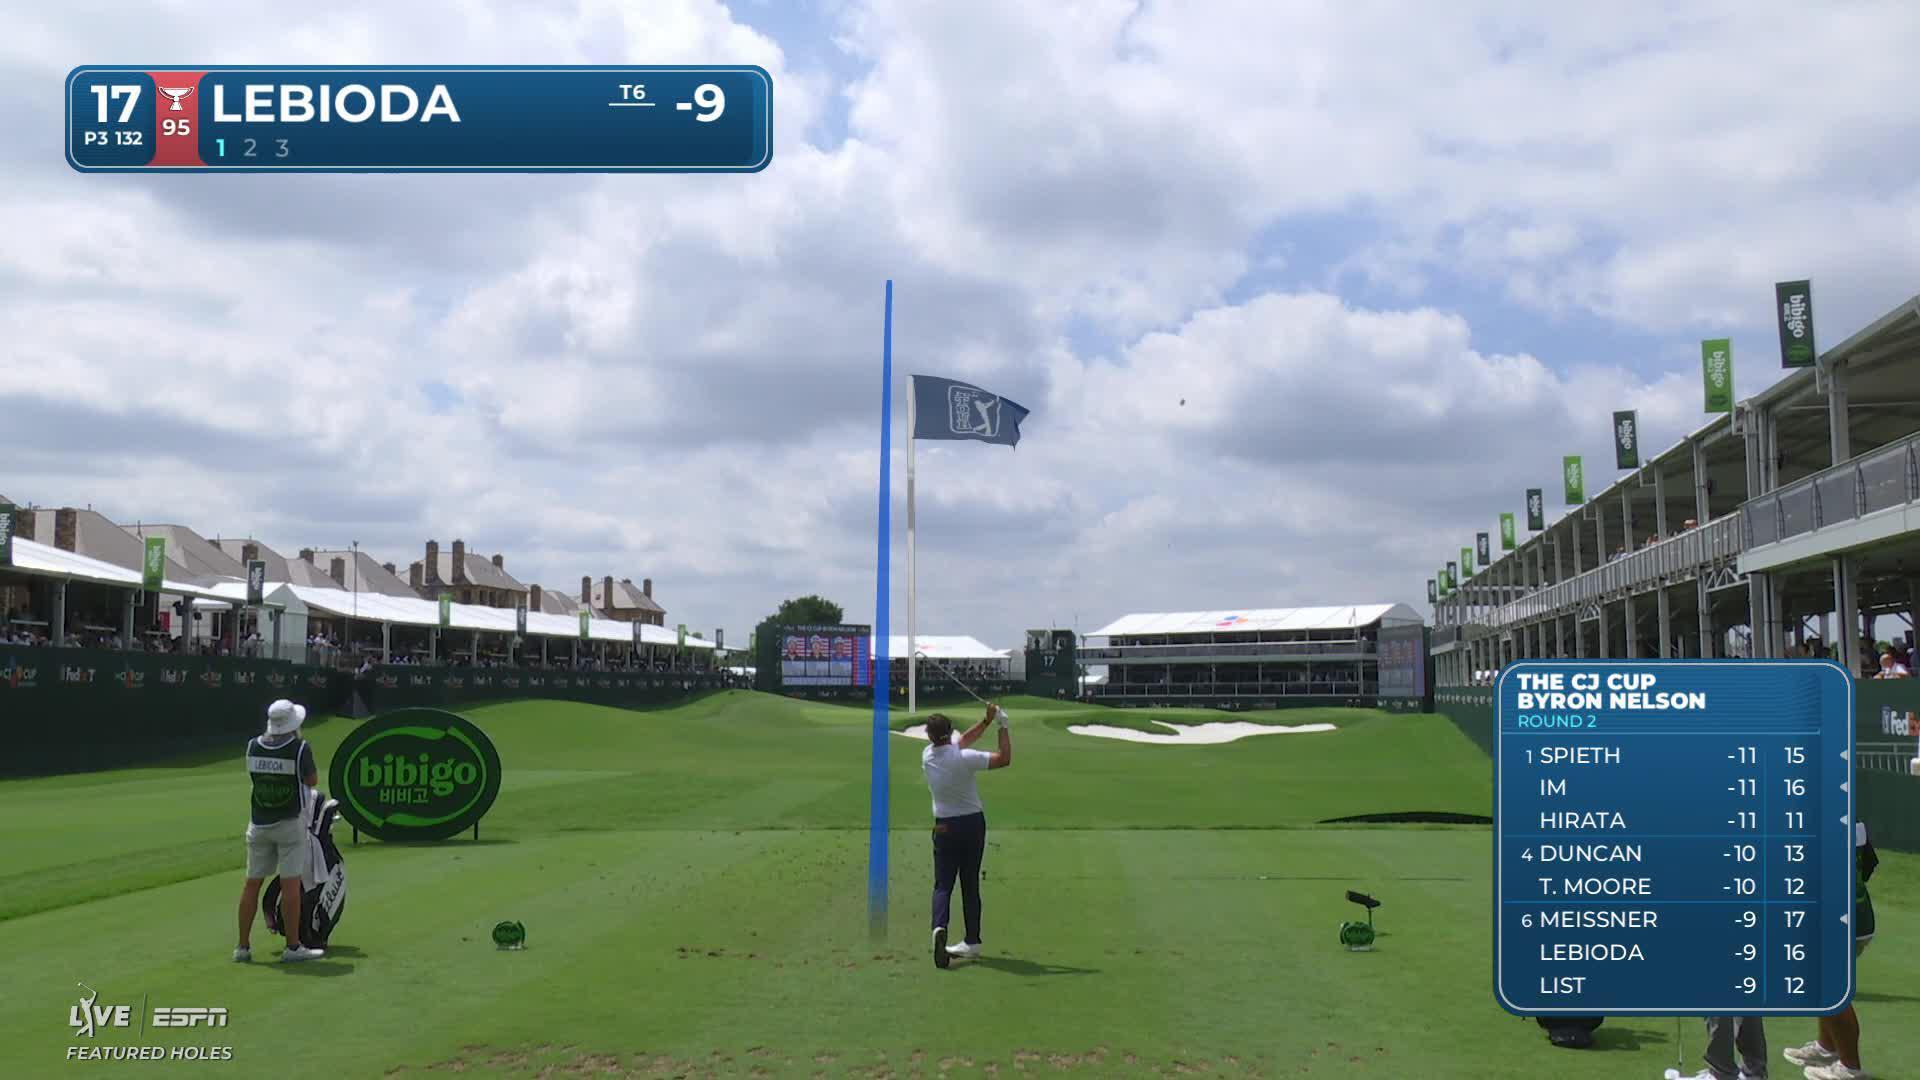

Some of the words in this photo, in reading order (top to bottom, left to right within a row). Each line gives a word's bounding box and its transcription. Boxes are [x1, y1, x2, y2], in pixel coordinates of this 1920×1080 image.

[1787, 294, 1807, 338] bibigo
[1711, 351, 1726, 388] bibigo
[1044, 655, 1055, 667] 17
[359, 752, 477, 797] bibigo
[379, 787, 429, 804] 비비고
